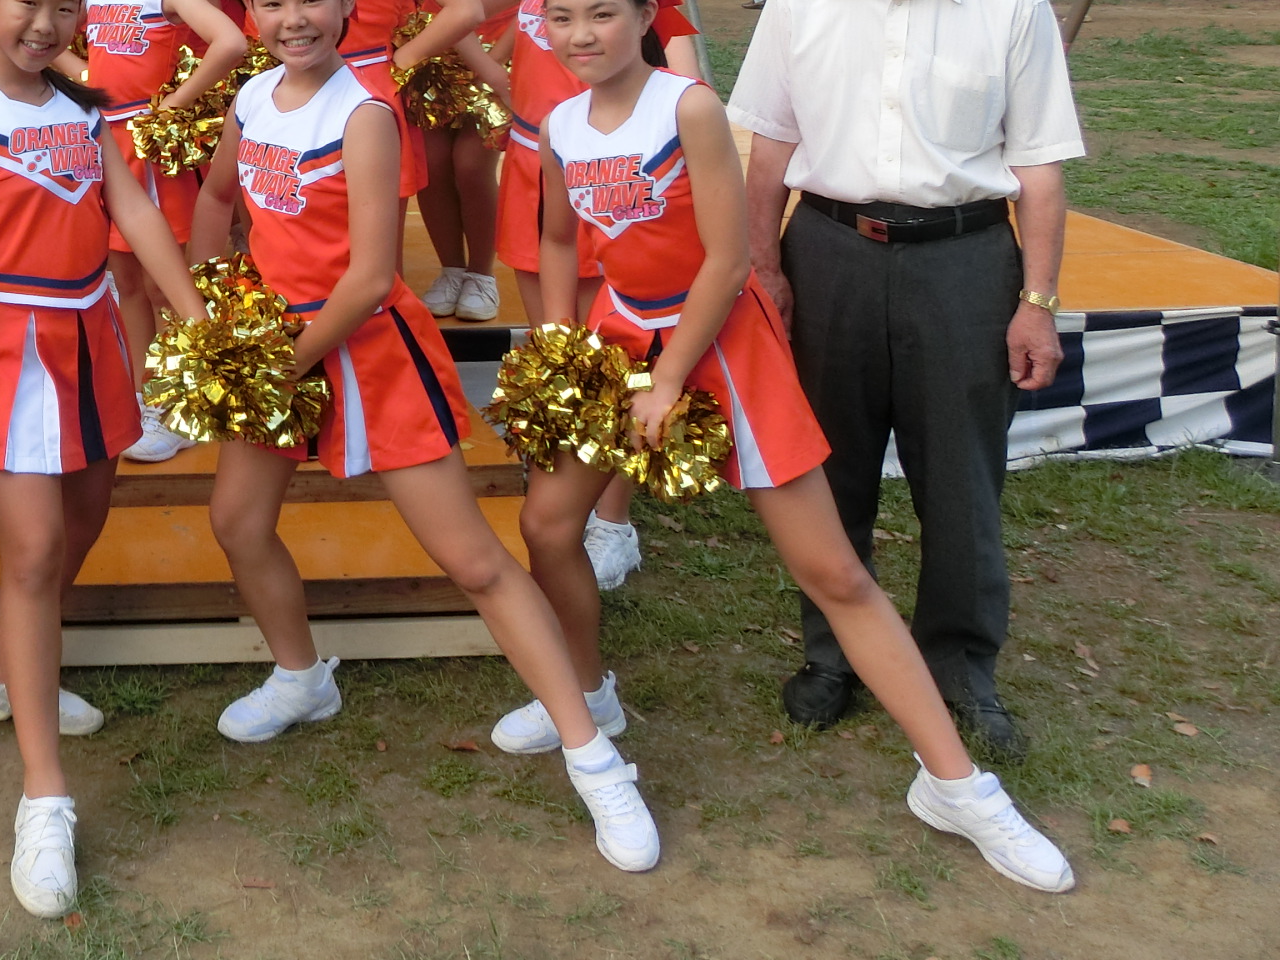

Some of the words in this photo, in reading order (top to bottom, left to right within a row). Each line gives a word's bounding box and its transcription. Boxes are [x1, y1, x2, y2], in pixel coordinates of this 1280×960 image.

[94, 24, 148, 47] WAVE
[9, 121, 94, 155] ORANGE
[49, 145, 99, 174] WAVE
[238, 137, 302, 178] ORANGE
[564, 153, 647, 190] ORANGE
[250, 168, 305, 205] WAVE
[591, 179, 665, 214] WAVE
[611, 203, 662, 221] Girls
